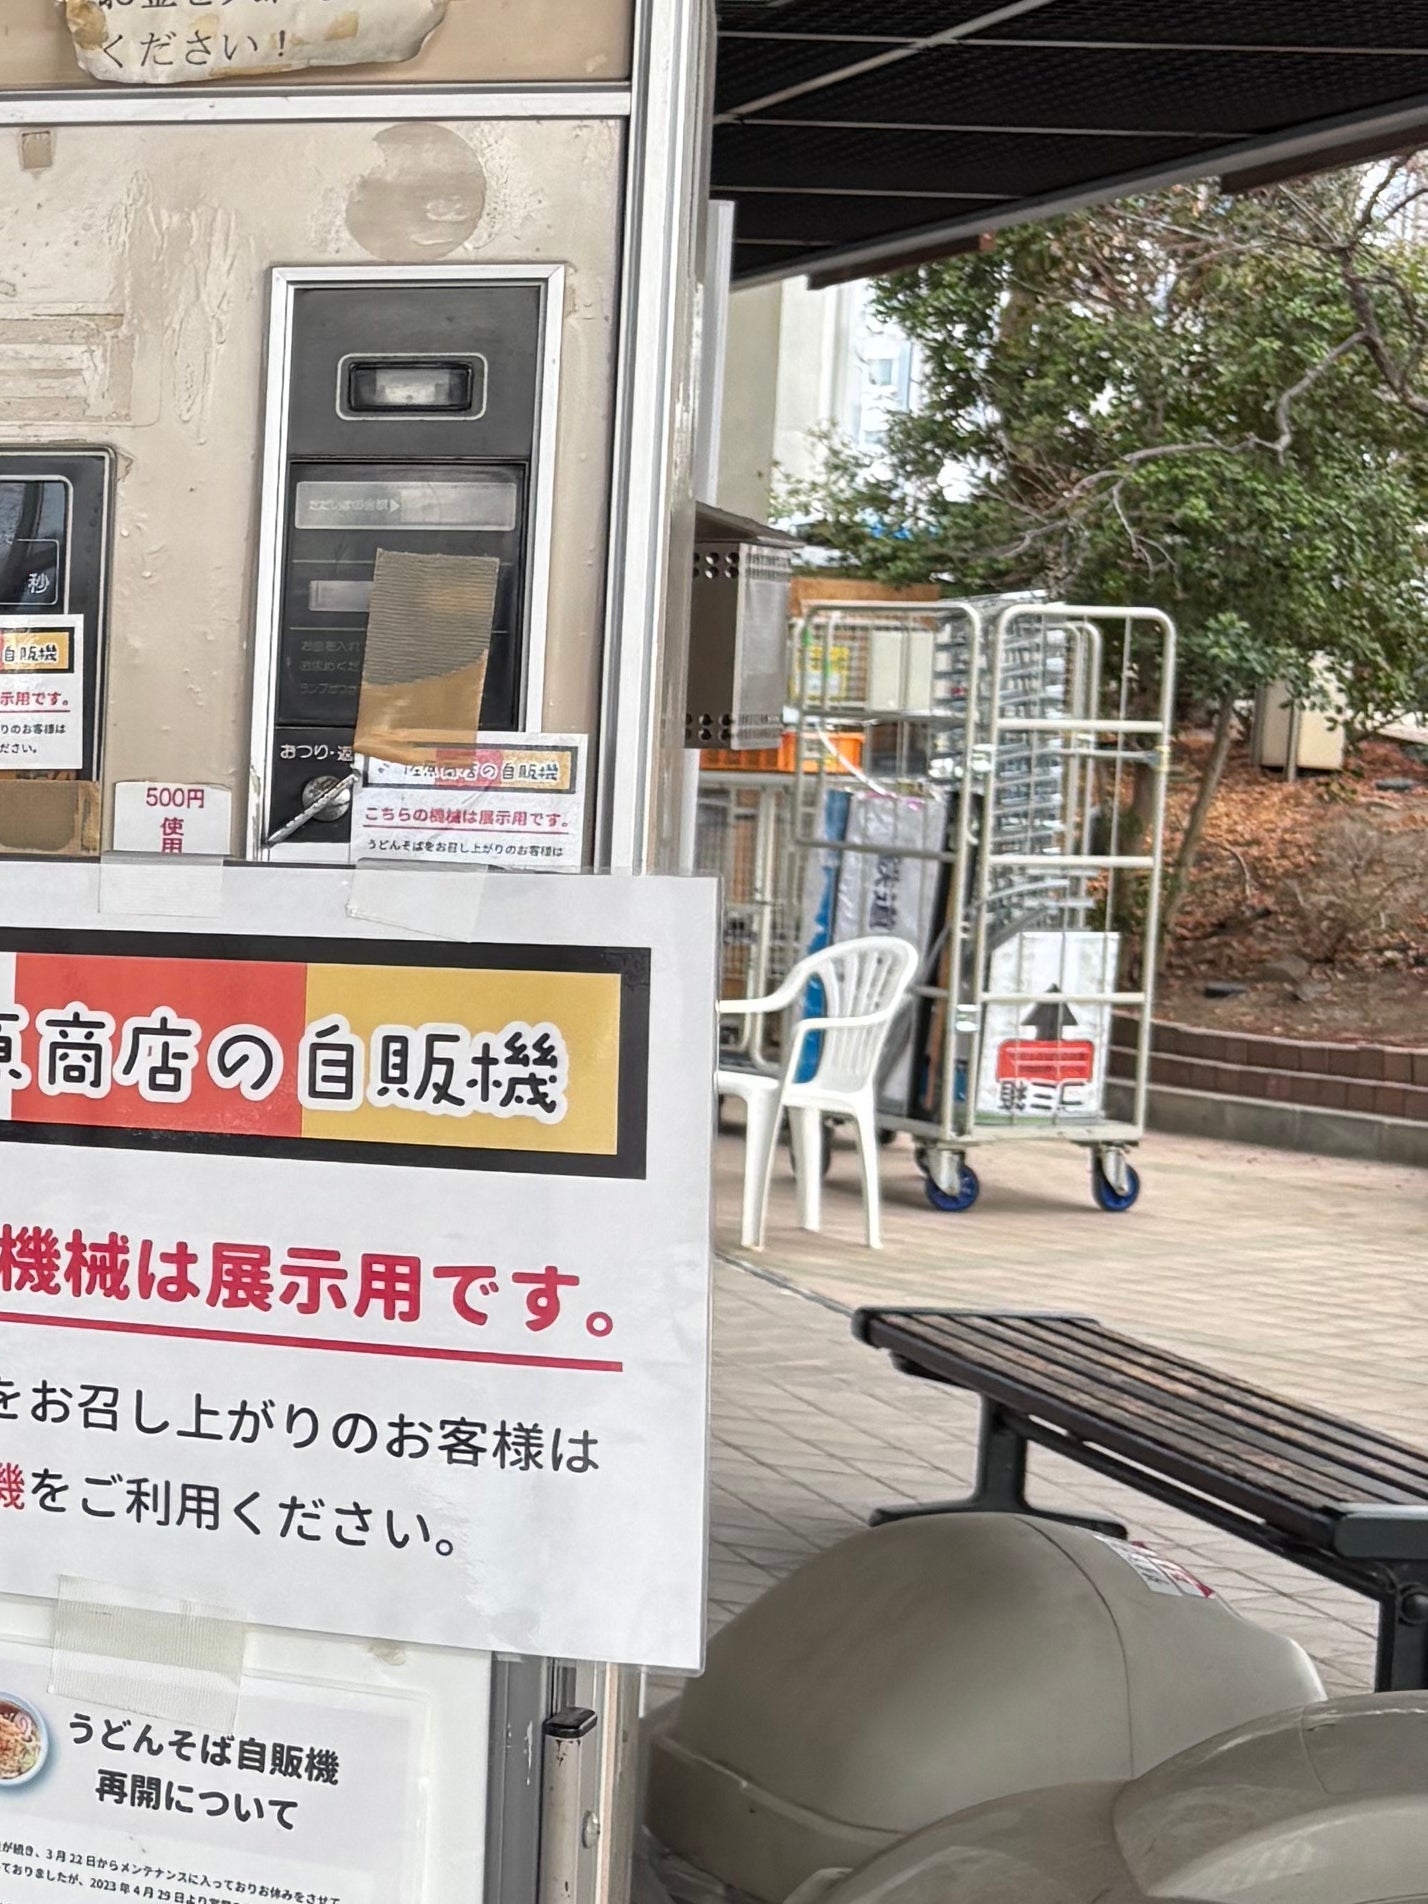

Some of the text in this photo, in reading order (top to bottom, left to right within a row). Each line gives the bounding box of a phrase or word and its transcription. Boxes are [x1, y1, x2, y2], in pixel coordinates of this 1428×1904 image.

[101, 30, 287, 68] ください！
[28, 572, 50, 593] 秒
[145, 788, 205, 809] 500円
[365, 807, 570, 828] こちらの機械は展示用です。
[369, 840, 564, 857] うどんそばをお召し上がりのお客様は
[69, 1712, 340, 1786] うどんそば自販機
[95, 1770, 298, 1830] 再開について
